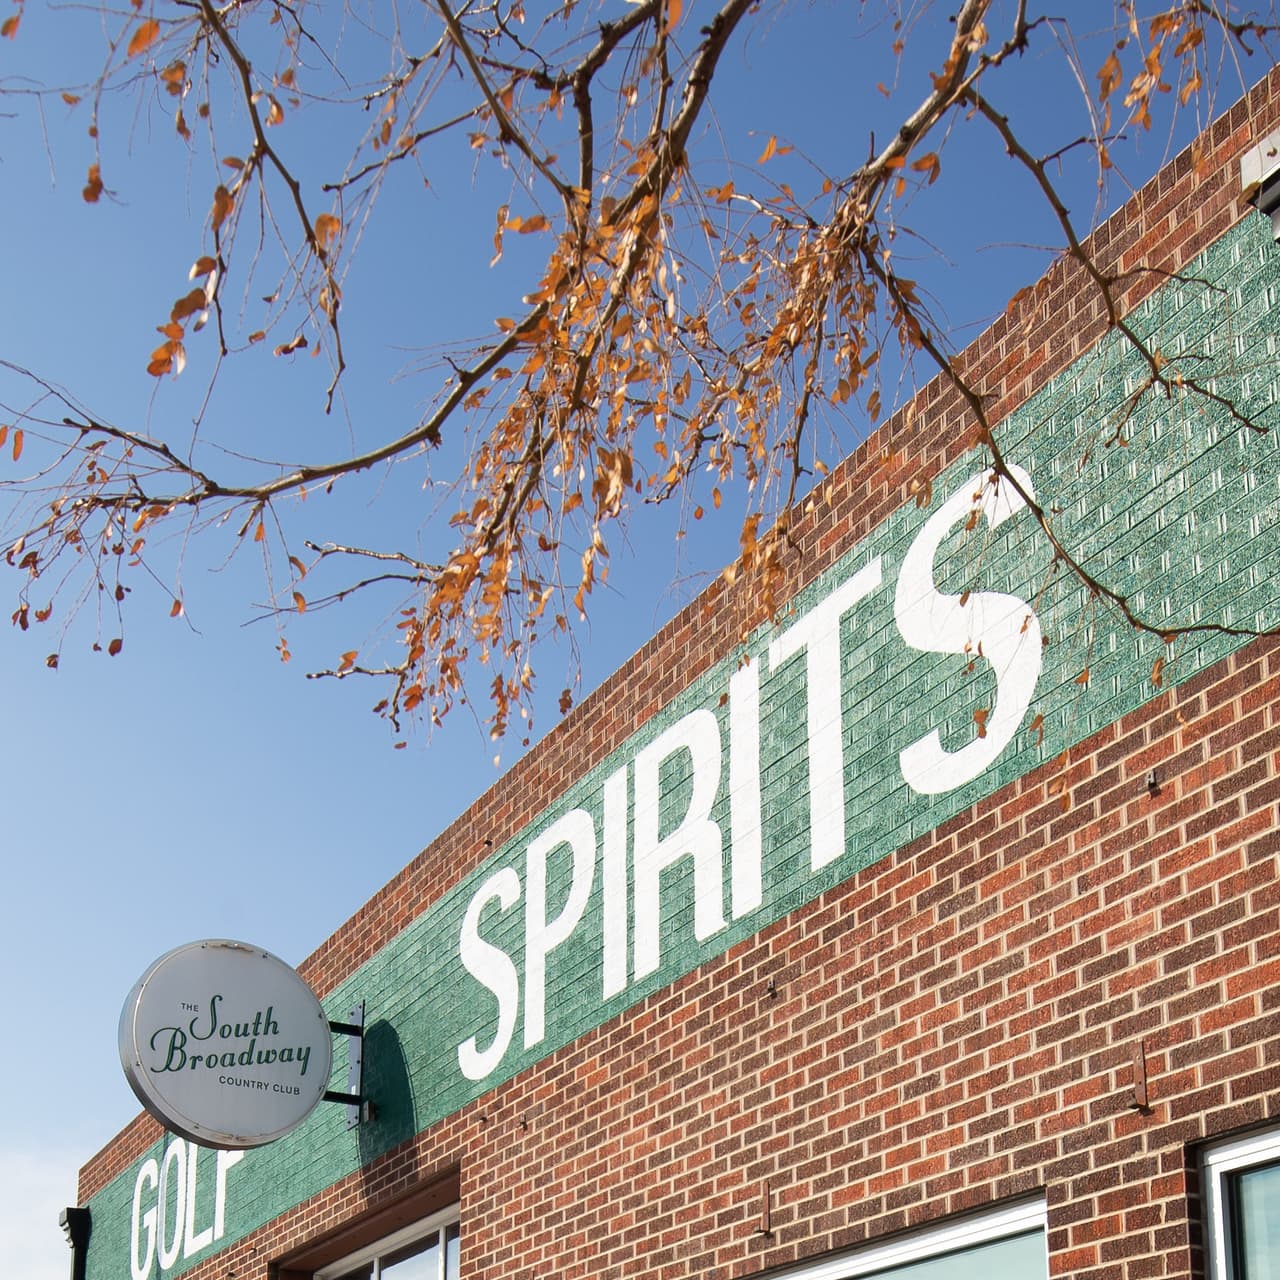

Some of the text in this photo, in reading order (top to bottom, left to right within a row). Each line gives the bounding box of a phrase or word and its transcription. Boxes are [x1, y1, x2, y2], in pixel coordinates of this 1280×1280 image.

[457, 463, 1043, 1080] SPIRITS
[181, 994, 279, 1040] THE South
[150, 1027, 311, 1076] Broadway
[219, 1075, 300, 1095] COUNTRY CLUB
